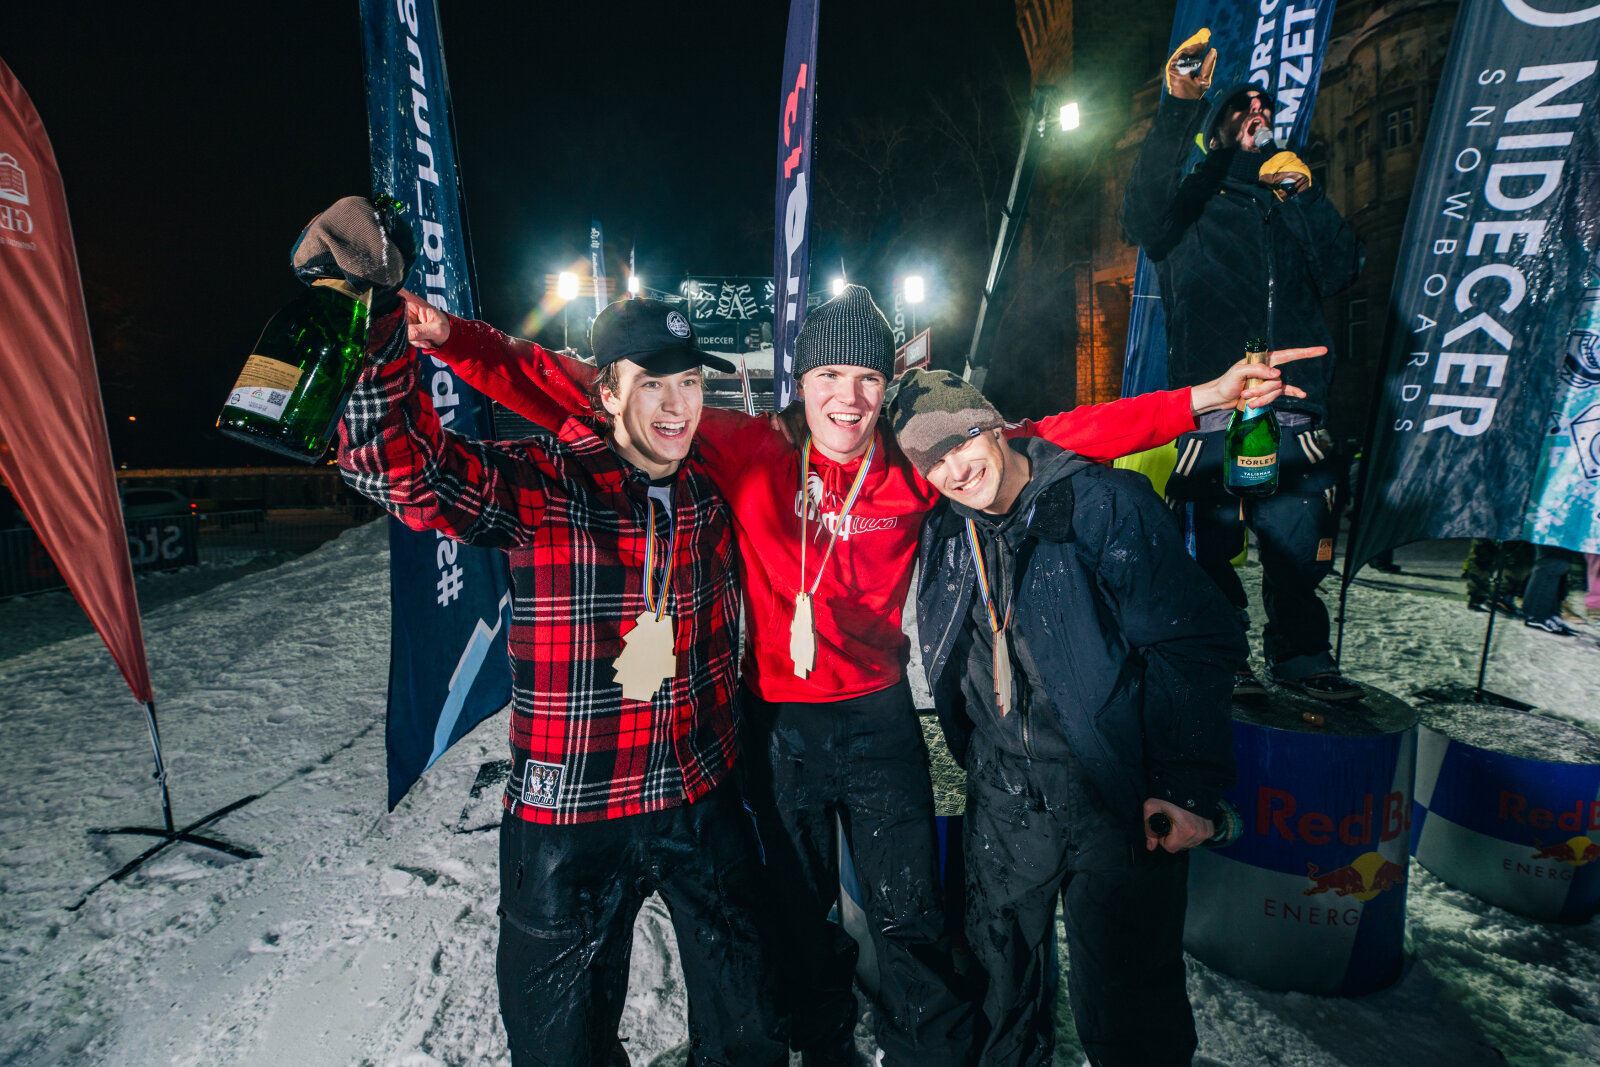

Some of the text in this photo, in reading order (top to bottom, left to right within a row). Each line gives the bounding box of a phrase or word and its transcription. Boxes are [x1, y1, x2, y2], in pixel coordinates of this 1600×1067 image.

[1394, 69, 1506, 431] SNOWBOARDS
[1422, 60, 1598, 436] NIDECKER
[698, 336, 734, 345] IDECKER
[1241, 457, 1274, 466] TÖRLEY
[1256, 785, 1374, 846] Red
[1498, 789, 1584, 832] Red
[1503, 858, 1573, 881] ENERG
[1264, 898, 1360, 927] ENERG
